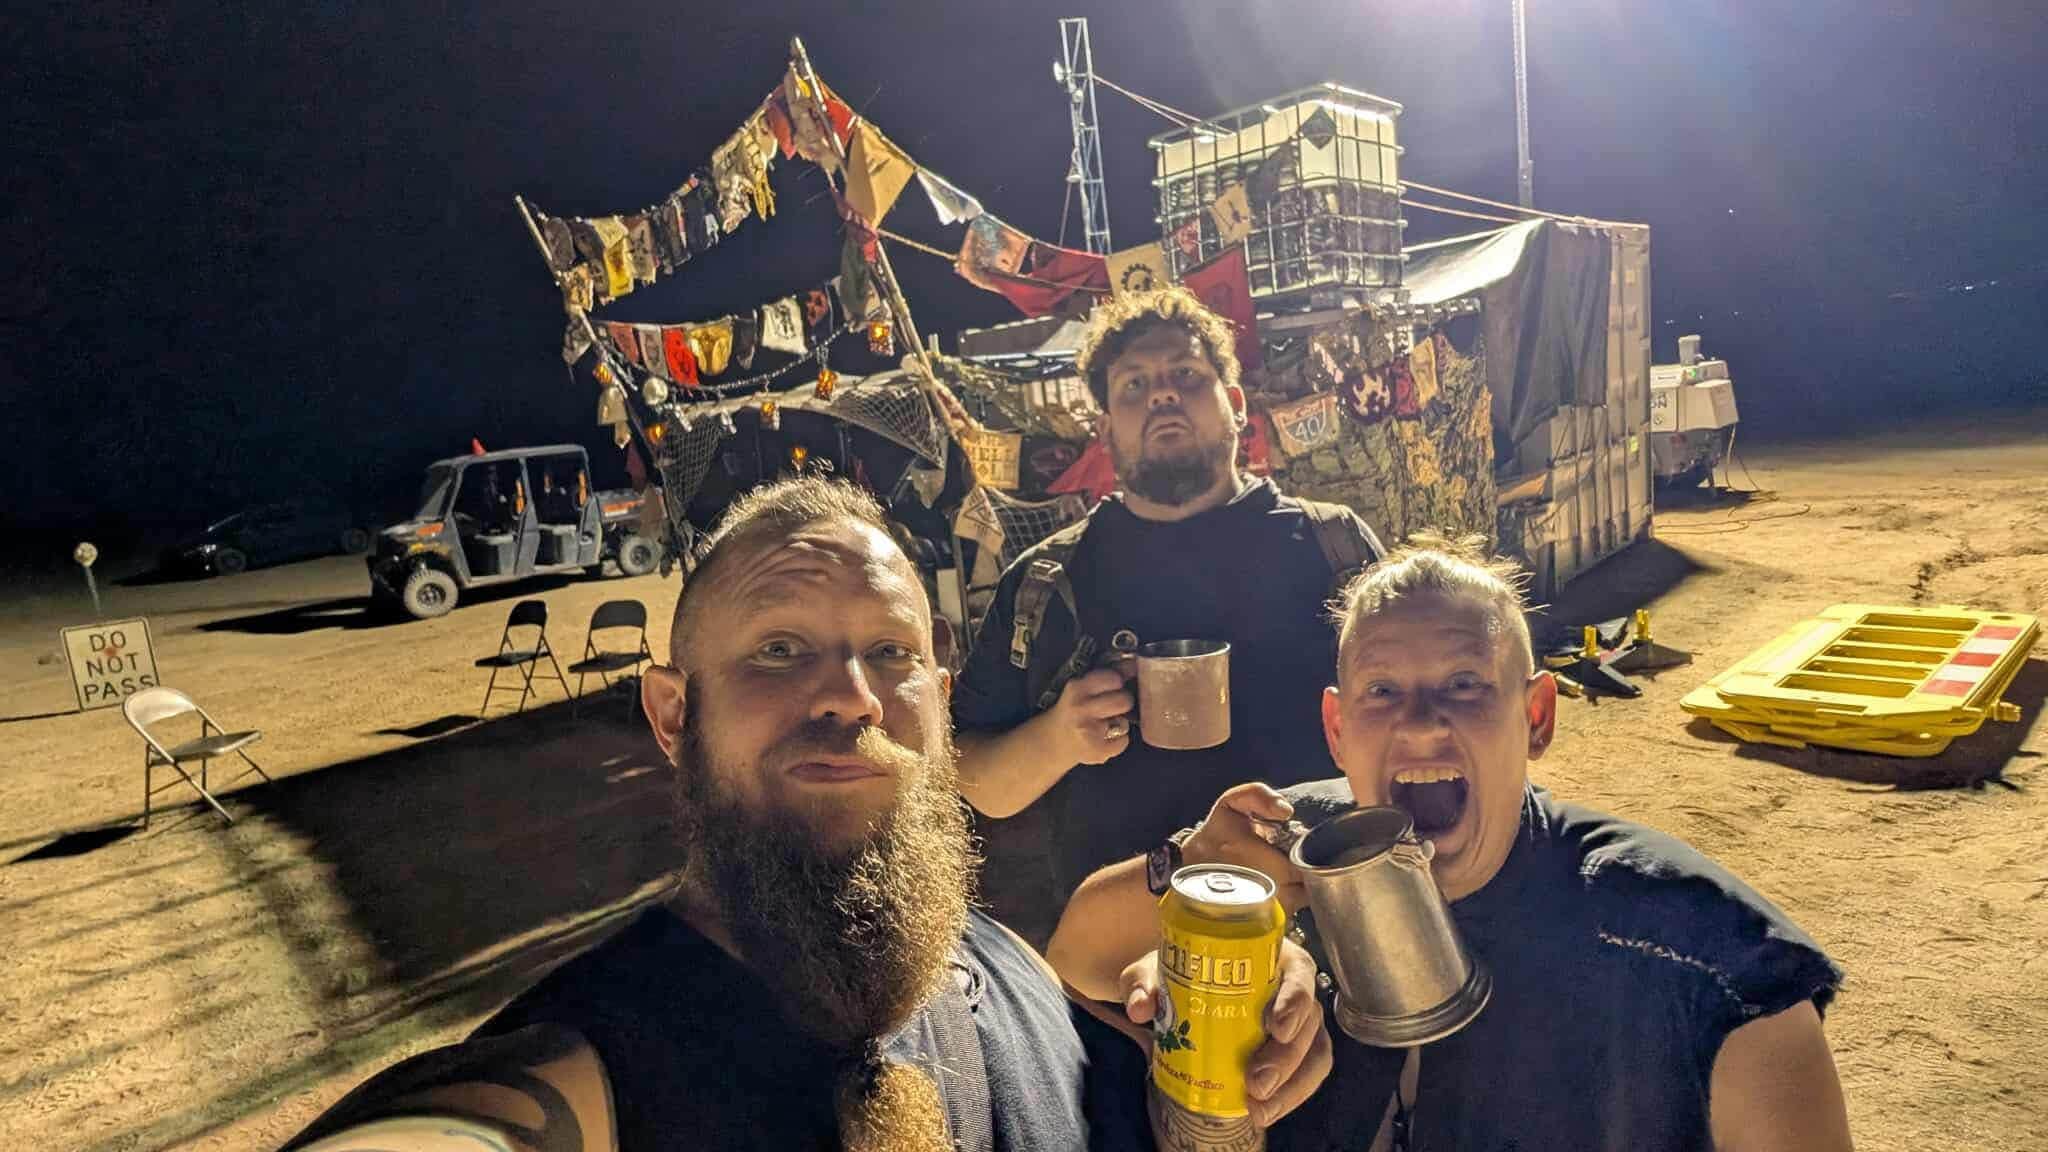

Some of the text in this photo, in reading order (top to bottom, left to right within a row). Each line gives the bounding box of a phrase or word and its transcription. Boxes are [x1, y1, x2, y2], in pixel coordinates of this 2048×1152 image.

[1295, 414, 1323, 442] 40
[89, 631, 126, 652] DO
[85, 652, 138, 678] NOT
[83, 674, 154, 702] PASS
